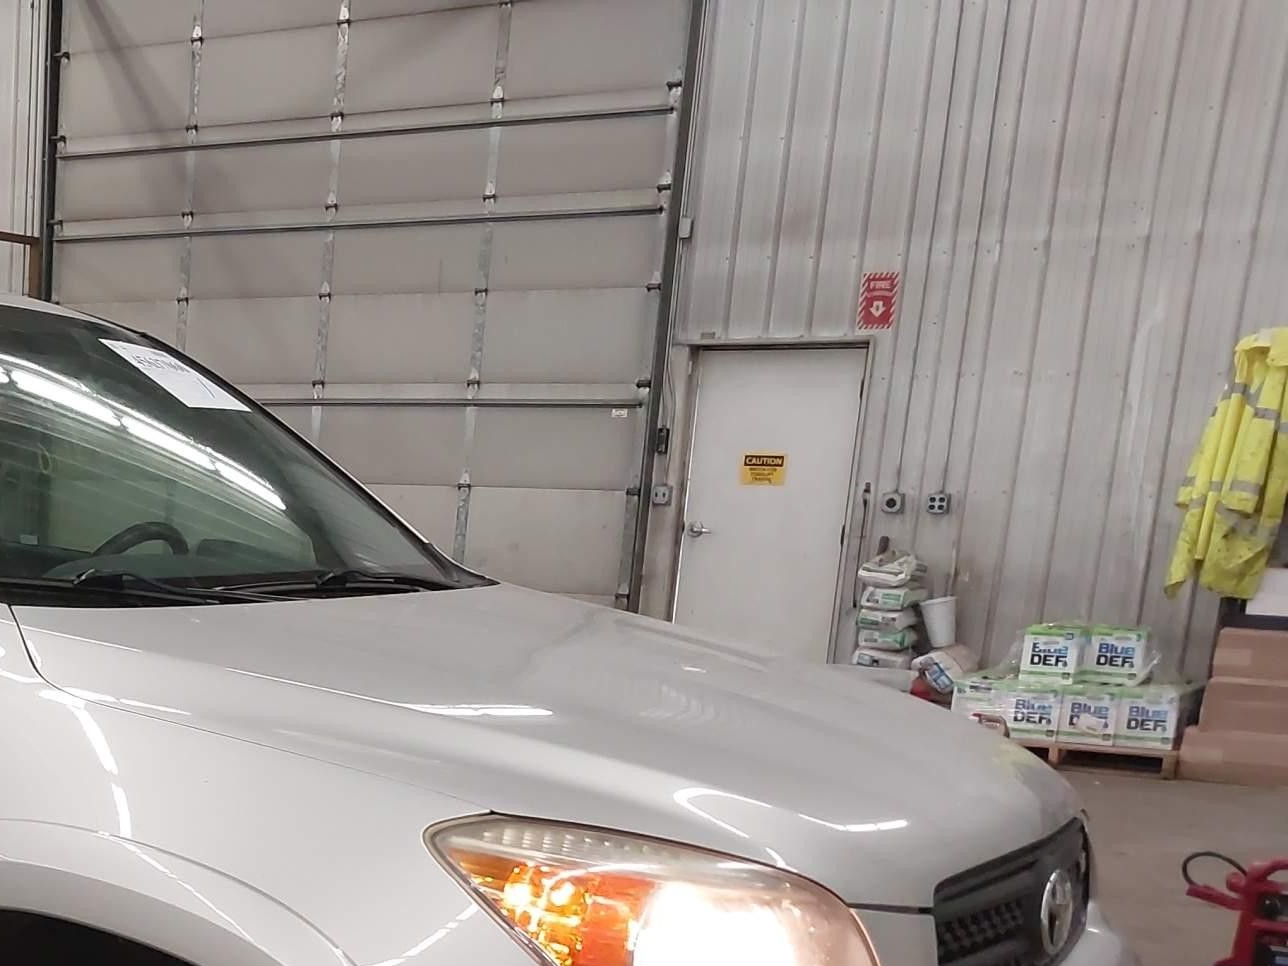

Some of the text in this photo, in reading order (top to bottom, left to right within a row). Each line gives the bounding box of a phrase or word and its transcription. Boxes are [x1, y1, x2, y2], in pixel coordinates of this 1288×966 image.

[745, 457, 783, 465] CAUTION
[1098, 643, 1136, 656] Blue
[1030, 653, 1068, 667] DEF
[1095, 654, 1135, 668] DEF
[1015, 698, 1053, 712] Blue
[1071, 702, 1110, 716] Blue
[1013, 711, 1051, 725] DEF
[1129, 706, 1169, 719] Blue
[1126, 718, 1167, 732] DEF
